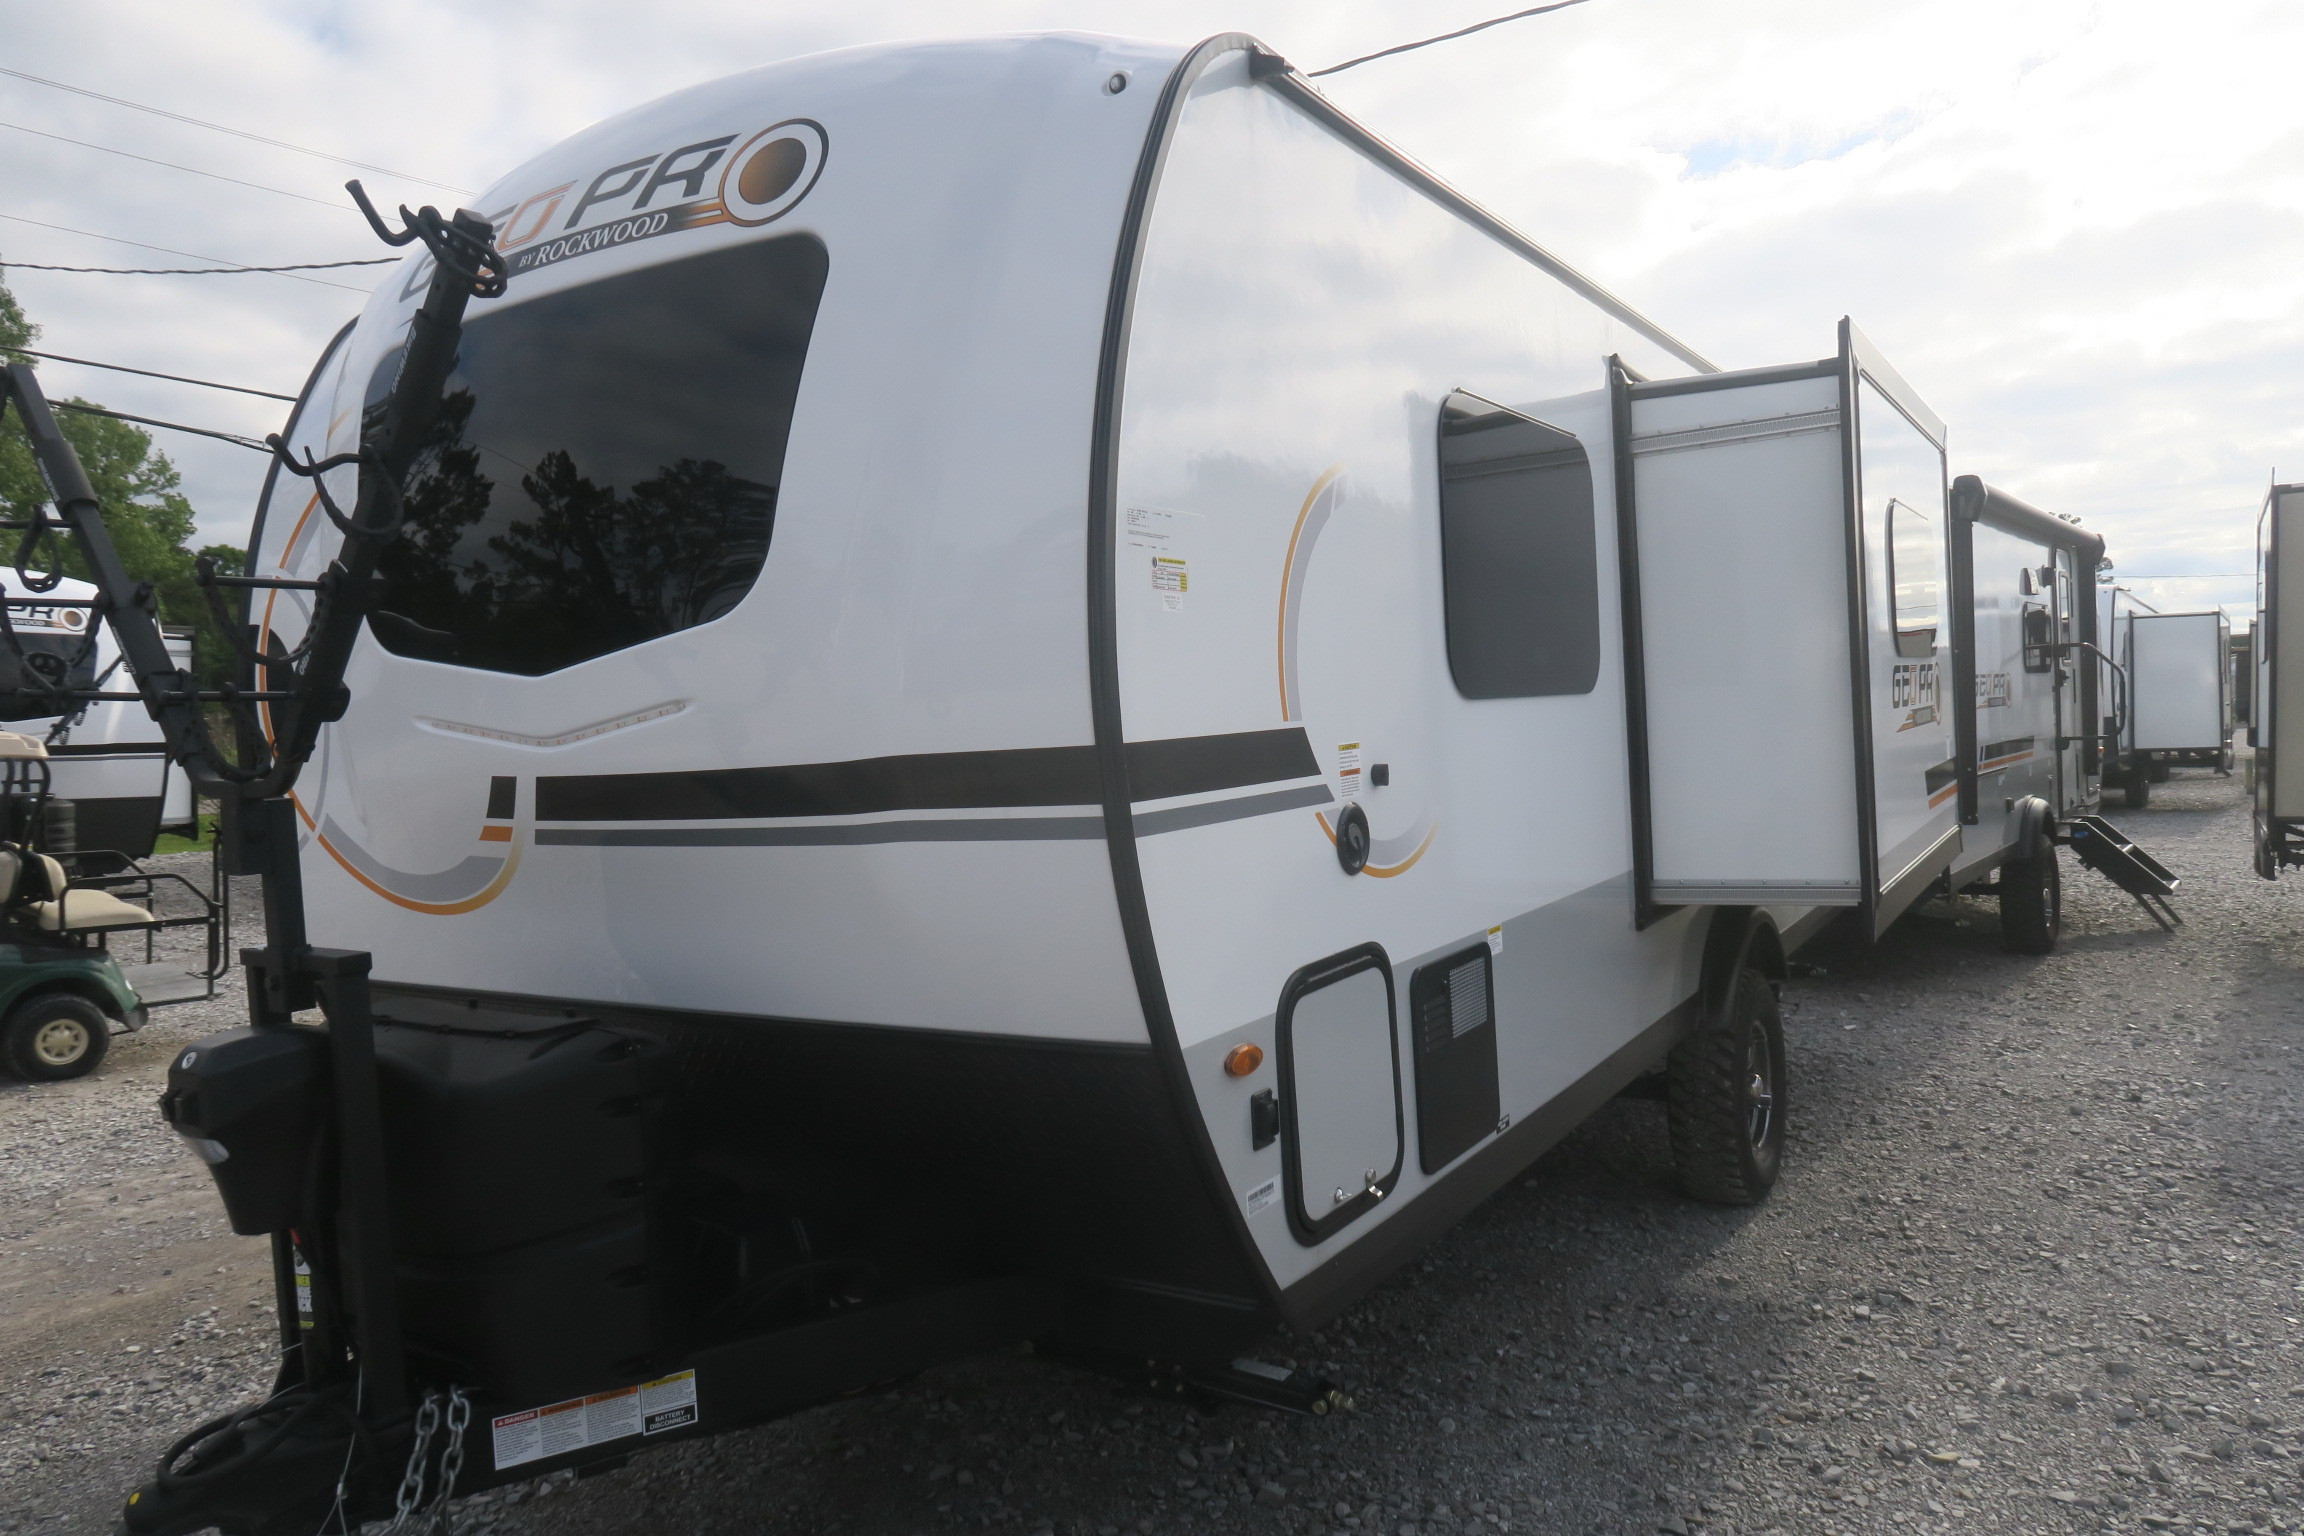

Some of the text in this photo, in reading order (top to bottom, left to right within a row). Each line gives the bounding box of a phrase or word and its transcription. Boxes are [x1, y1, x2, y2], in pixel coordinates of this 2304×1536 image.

[518, 211, 669, 269] BY ROCKWOOD
[504, 1412, 536, 1425] DANGER
[649, 1414, 692, 1430] DISCONNECT
[655, 1410, 685, 1422] BATTERY
